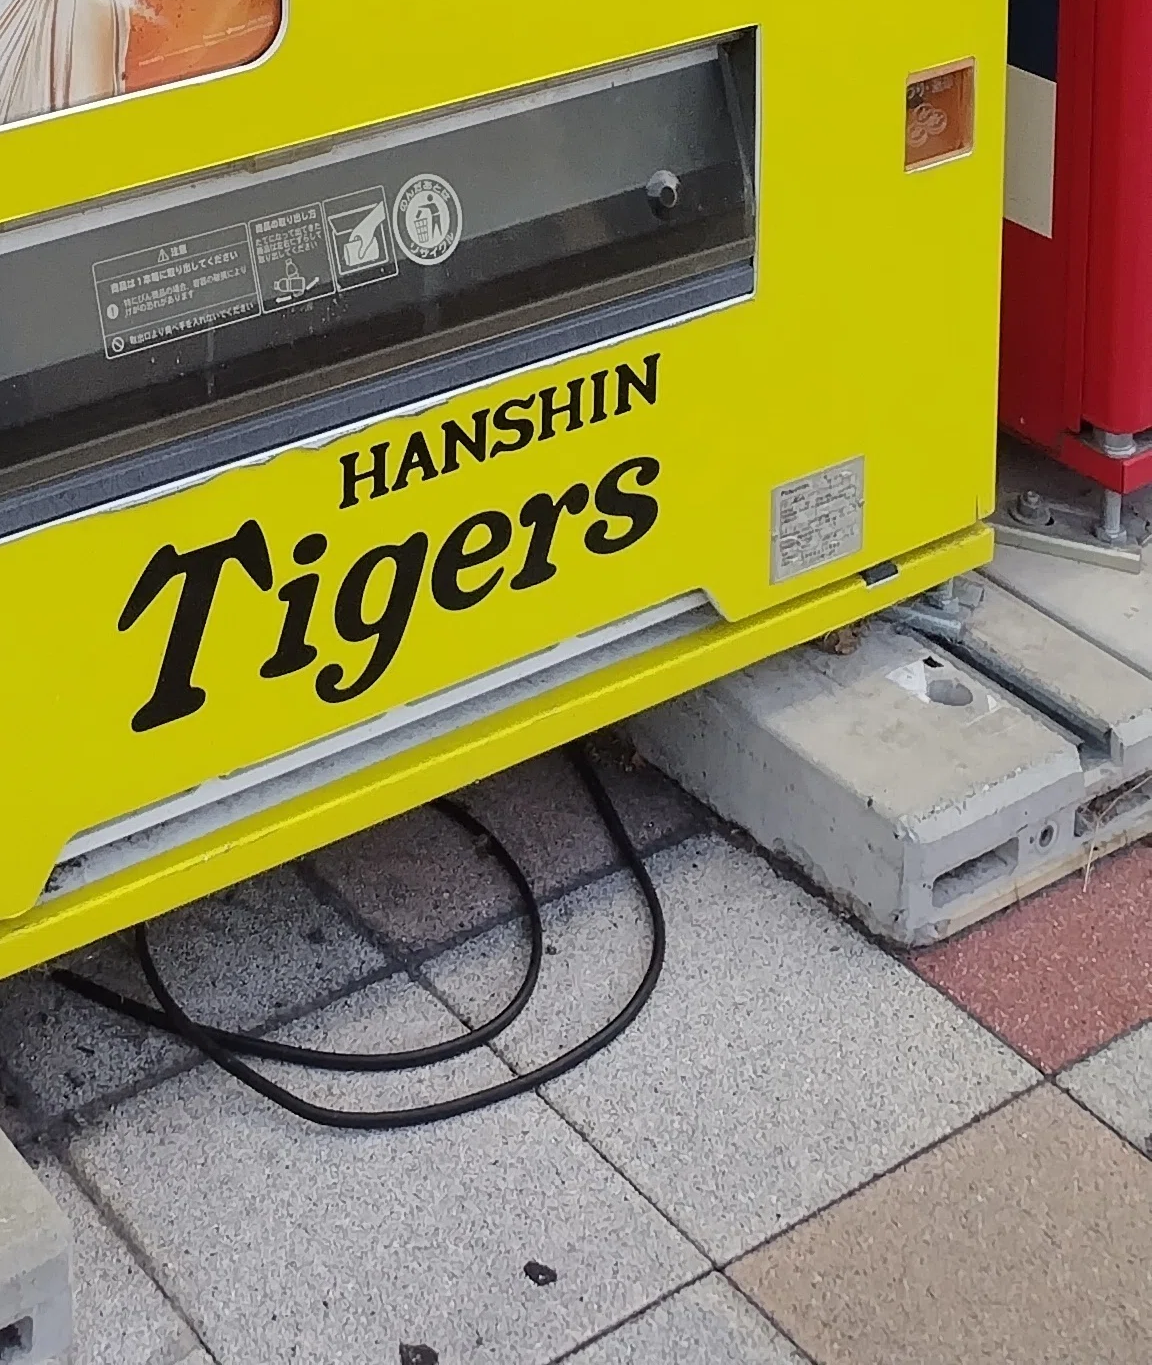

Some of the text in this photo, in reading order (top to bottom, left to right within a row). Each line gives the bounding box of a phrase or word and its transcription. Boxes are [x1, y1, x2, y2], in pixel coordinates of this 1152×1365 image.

[399, 179, 451, 213] のんだあとは
[409, 231, 455, 259] リサイクル
[338, 350, 661, 511] HANSHIN
[117, 453, 661, 733] Tigers
